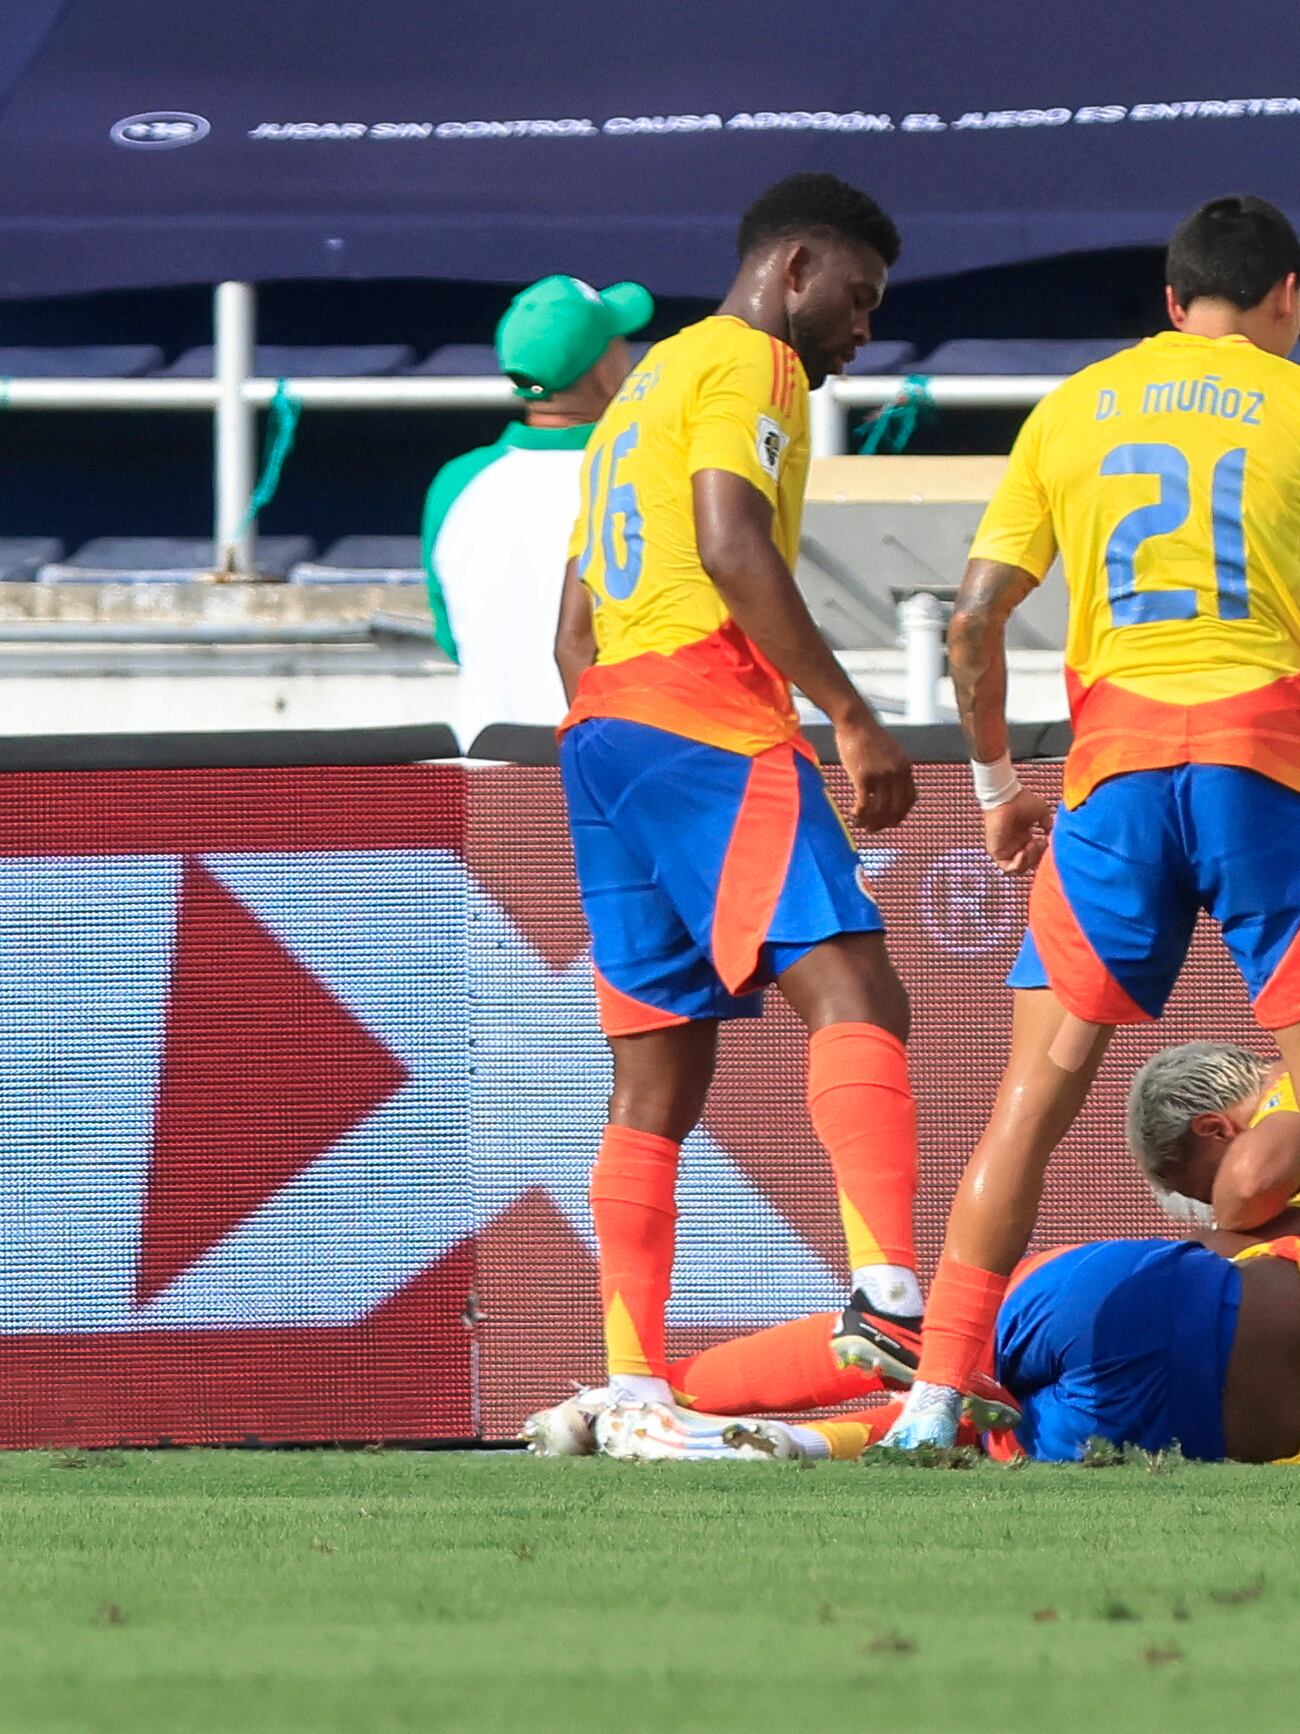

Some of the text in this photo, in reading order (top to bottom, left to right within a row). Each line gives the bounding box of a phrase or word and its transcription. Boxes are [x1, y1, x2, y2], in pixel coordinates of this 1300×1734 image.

[247, 121, 367, 140] JUGAR
[367, 121, 433, 140] SIN
[433, 119, 599, 139] CONTROL
[602, 113, 722, 136] CAUSA
[900, 113, 948, 132] EL
[949, 107, 1072, 131] JUEGO
[1072, 104, 1127, 125] ES
[1095, 374, 1266, 426] D. MUÑOZ
[1099, 442, 1251, 629] 21
